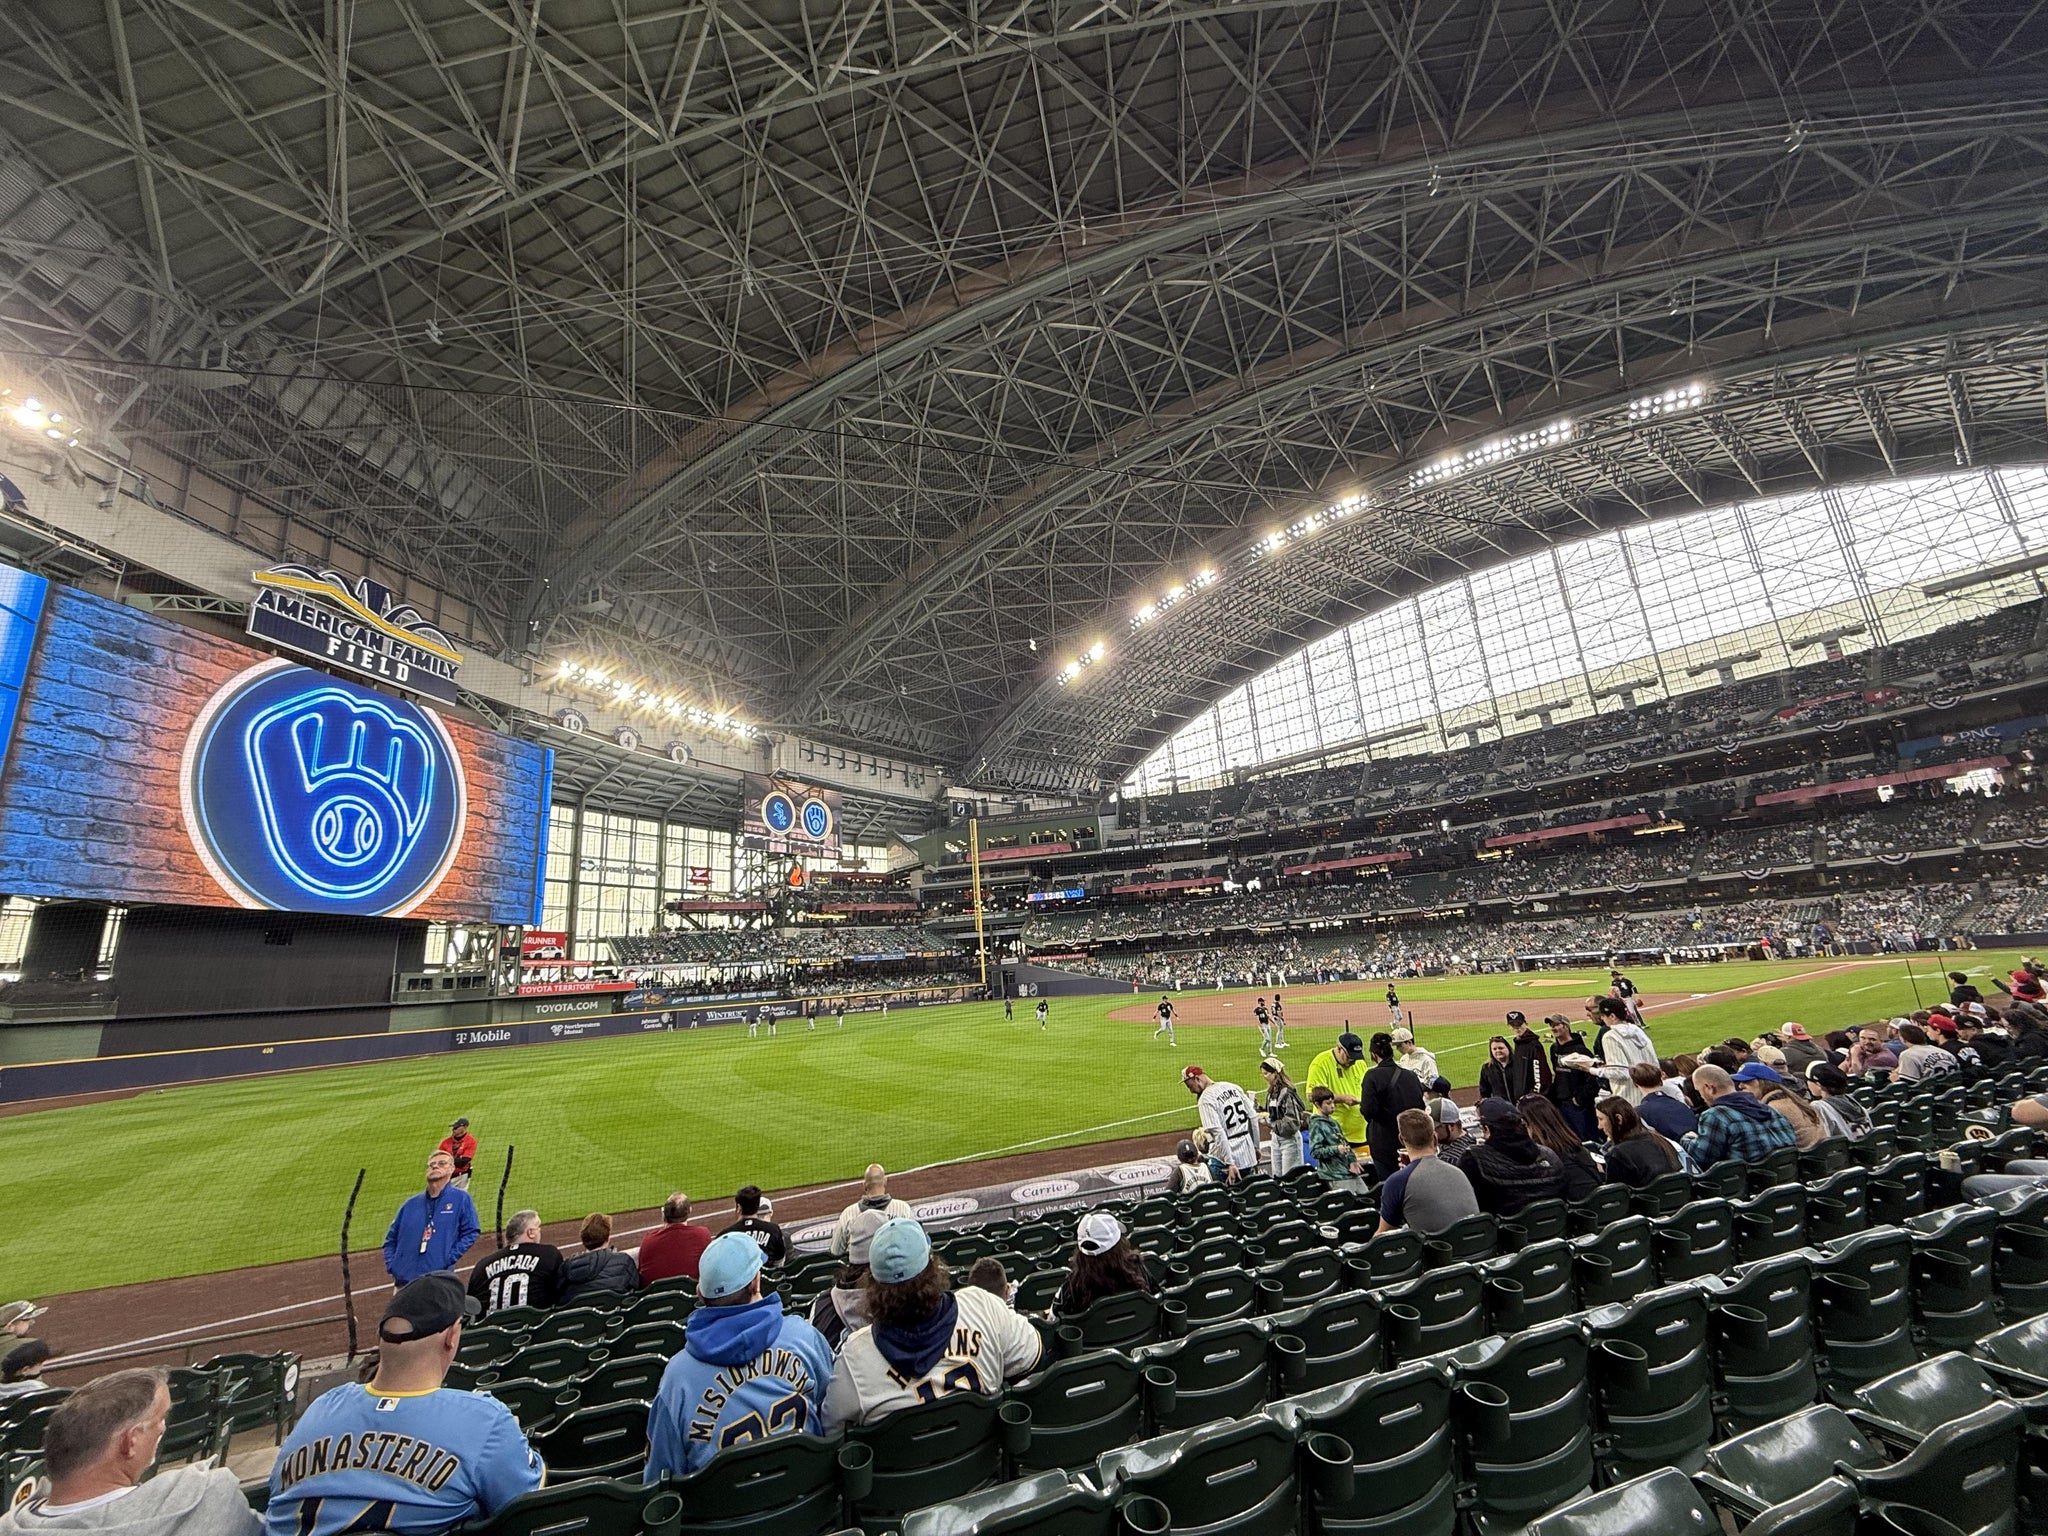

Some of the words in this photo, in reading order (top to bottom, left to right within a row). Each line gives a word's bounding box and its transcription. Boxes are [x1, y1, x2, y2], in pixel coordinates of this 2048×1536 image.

[254, 586, 385, 651] AMERICAN
[389, 638, 460, 681] FAMILY
[326, 637, 410, 682] FIELD
[1958, 725, 1999, 741] PNC
[523, 937, 556, 945] 4RUNNER
[787, 957, 800, 965] 620
[801, 956, 820, 964] WTMJ
[521, 985, 552, 994] TOYOTA
[555, 983, 595, 992] TERRITORY
[535, 1001, 598, 1014] TOYOTA.COM
[469, 1030, 511, 1043] Mobile
[1217, 1089, 1240, 1104] THOME
[1224, 1101, 1248, 1129] 25
[1118, 1167, 1163, 1180] Carrier
[1022, 1183, 1069, 1198] Carrier
[916, 1201, 968, 1218] Carrier
[485, 1254, 540, 1279] MONCADA
[486, 1272, 530, 1317] 10
[281, 1431, 460, 1494] MONASTERIO
